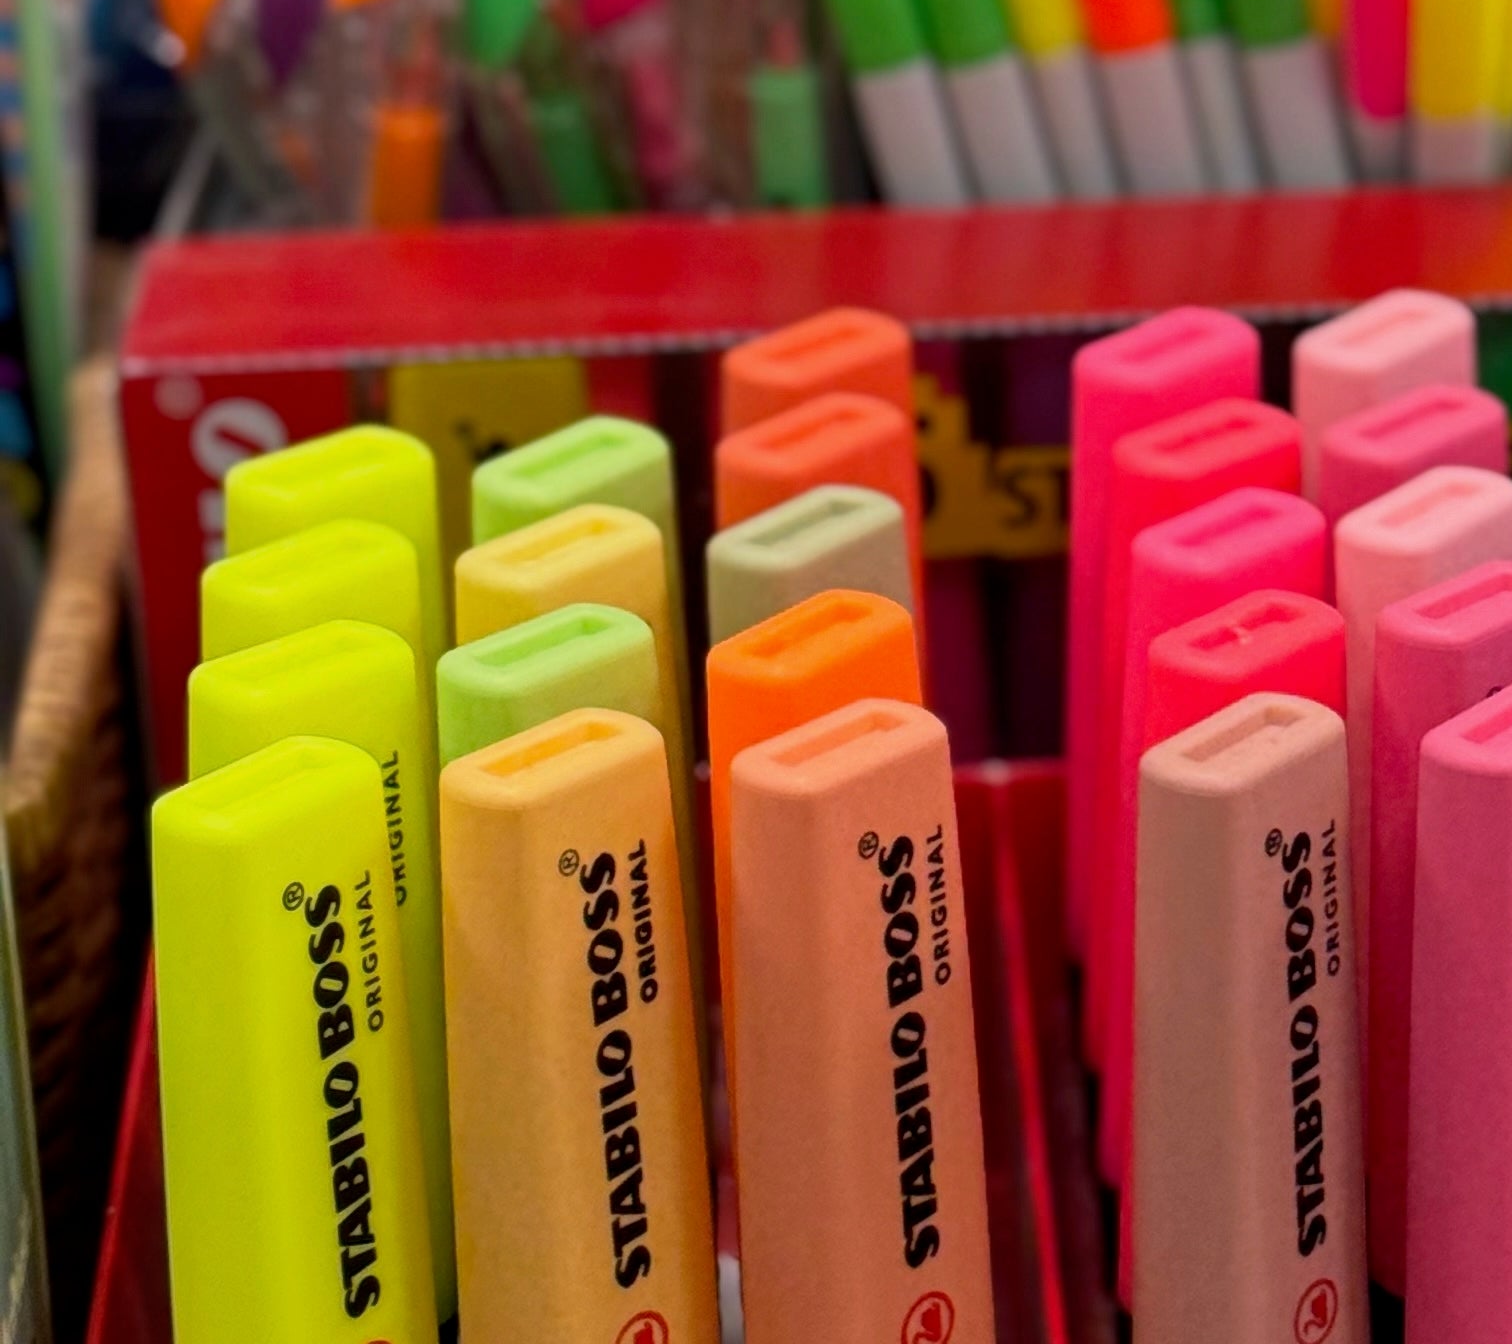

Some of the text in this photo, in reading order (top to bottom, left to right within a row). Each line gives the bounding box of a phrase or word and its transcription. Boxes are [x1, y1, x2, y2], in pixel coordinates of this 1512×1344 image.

[355, 870, 384, 1033] ORIGINAL
[629, 839, 659, 1004] ORIGINAL
[923, 824, 952, 986] ORIGINAL
[1323, 818, 1341, 977] ORIGINAL
[320, 1060, 380, 1319] STABILO
[596, 1028, 652, 1289] STABILO
[890, 1010, 940, 1270] STABILO
[1289, 1004, 1327, 1258] STABILO
